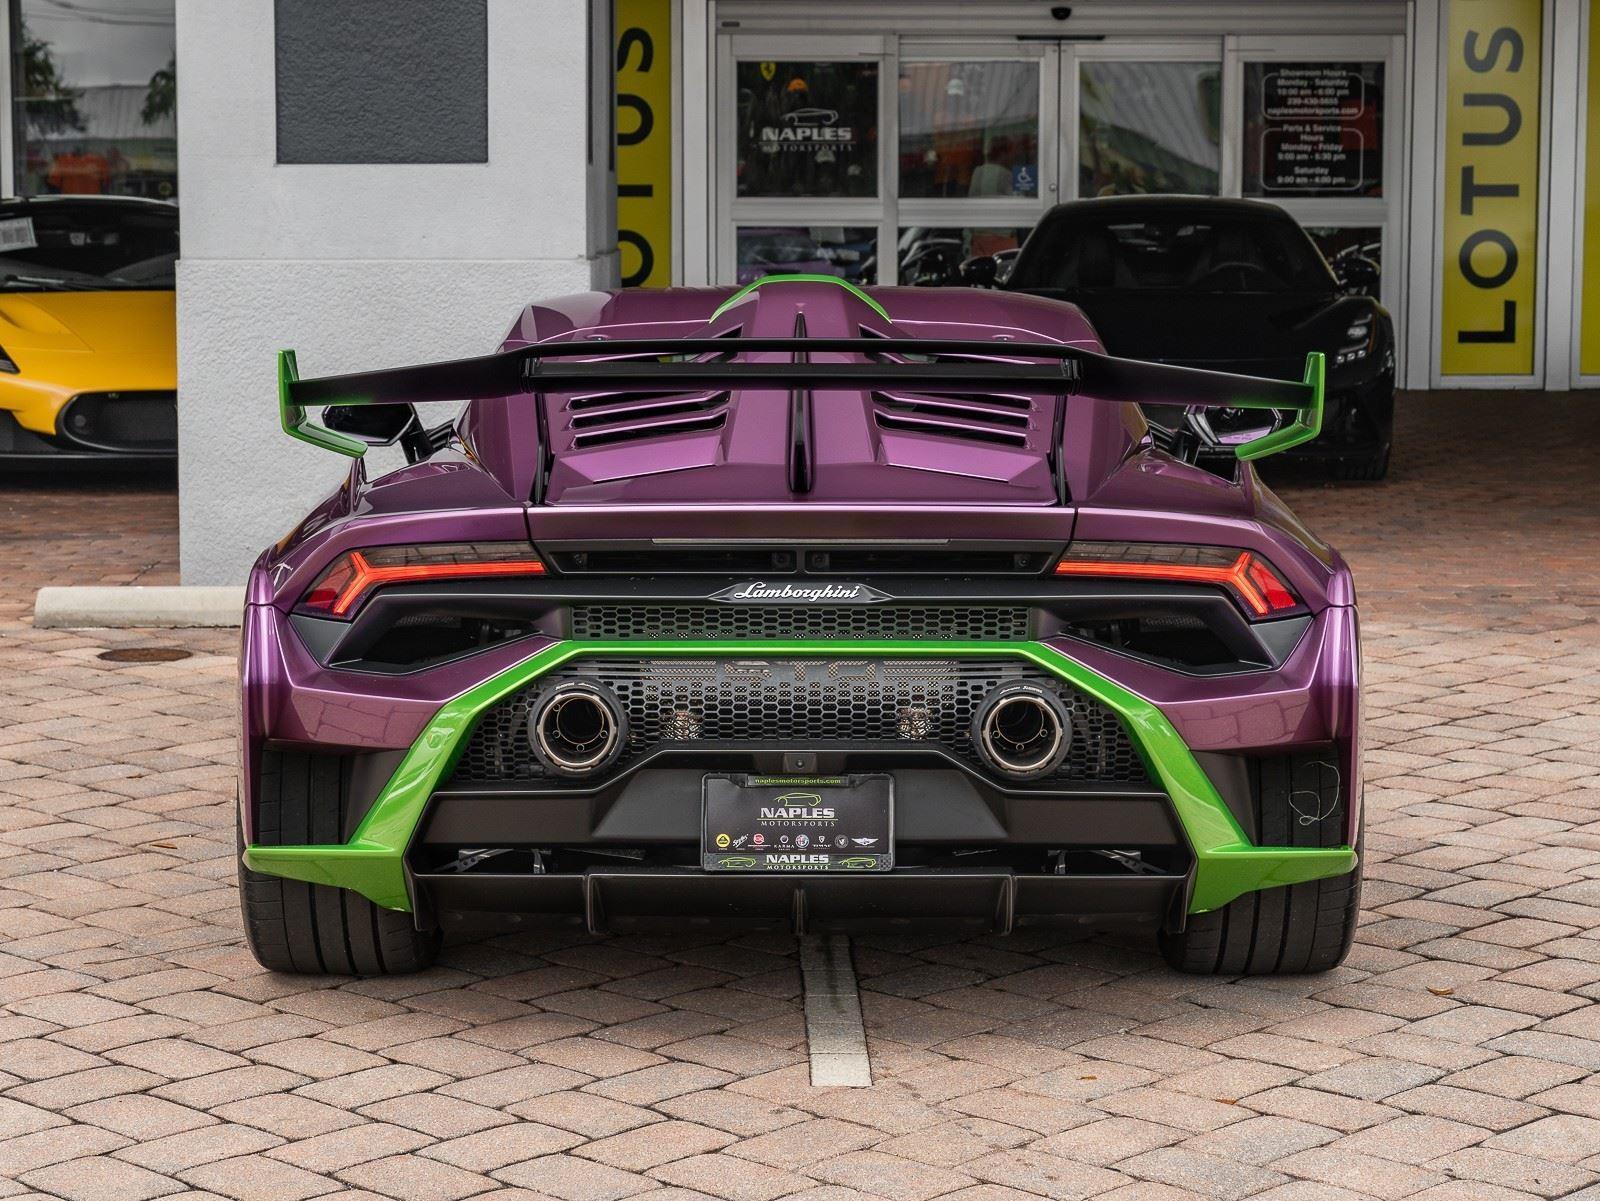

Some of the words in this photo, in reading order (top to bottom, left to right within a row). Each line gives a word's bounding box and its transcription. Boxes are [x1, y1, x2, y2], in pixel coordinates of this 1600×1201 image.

[1280, 69, 1322, 77] Showroom
[1323, 69, 1347, 77] Hours
[1277, 79, 1308, 87] Monday
[1315, 79, 1349, 87] Saturday
[1282, 124, 1303, 132] Parts
[1312, 124, 1342, 132] Service
[762, 127, 852, 141] NAPLES
[1300, 134, 1324, 142] Hours
[762, 144, 852, 152] MOTORSPORTS
[1281, 143, 1312, 152] Monday
[1318, 143, 1343, 152] Friday
[1294, 166, 1329, 175] Saturday
[1457, 26, 1524, 344] LOTUS
[734, 581, 861, 602] Lamborghini
[760, 807, 835, 819] NAPLES
[766, 854, 829, 864] NAPLES
